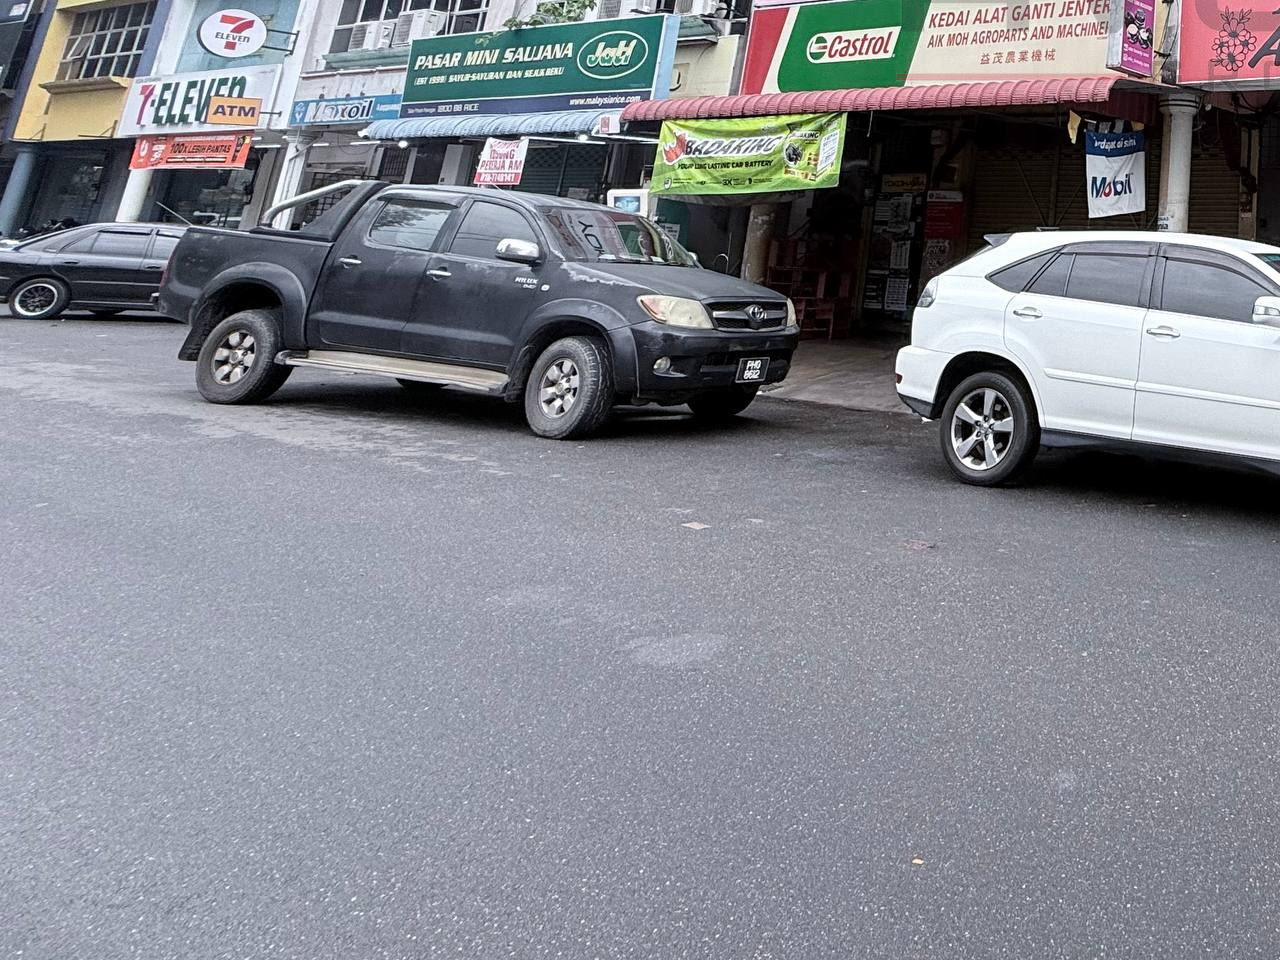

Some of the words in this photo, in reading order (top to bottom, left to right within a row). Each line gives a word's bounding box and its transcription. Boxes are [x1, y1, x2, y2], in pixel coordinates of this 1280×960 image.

[928, 10, 970, 28] KEDAI
[973, 7, 1008, 25] ALAT
[1011, 2, 1055, 22] GANTI
[219, 15, 255, 50] 7
[927, 34, 945, 48] AIK
[946, 32, 969, 46] MOH
[971, 27, 1028, 44] AGROPARTS
[1030, 25, 1055, 40] AND
[414, 51, 459, 70] PASAR
[463, 49, 499, 66] MINI
[502, 42, 574, 63] SAUJANA
[827, 31, 894, 58] Castrol
[980, 48, 1056, 65] 益茂農業機械
[506, 70, 522, 79] DAN
[212, 104, 256, 118] ATM
[304, 99, 375, 122] Maxoil
[206, 144, 232, 153] PANTAS
[685, 136, 781, 157] BADAKING
[731, 161, 743, 169] CAR
[744, 159, 774, 168] BATTERY
[1091, 173, 1132, 199] Mobil
